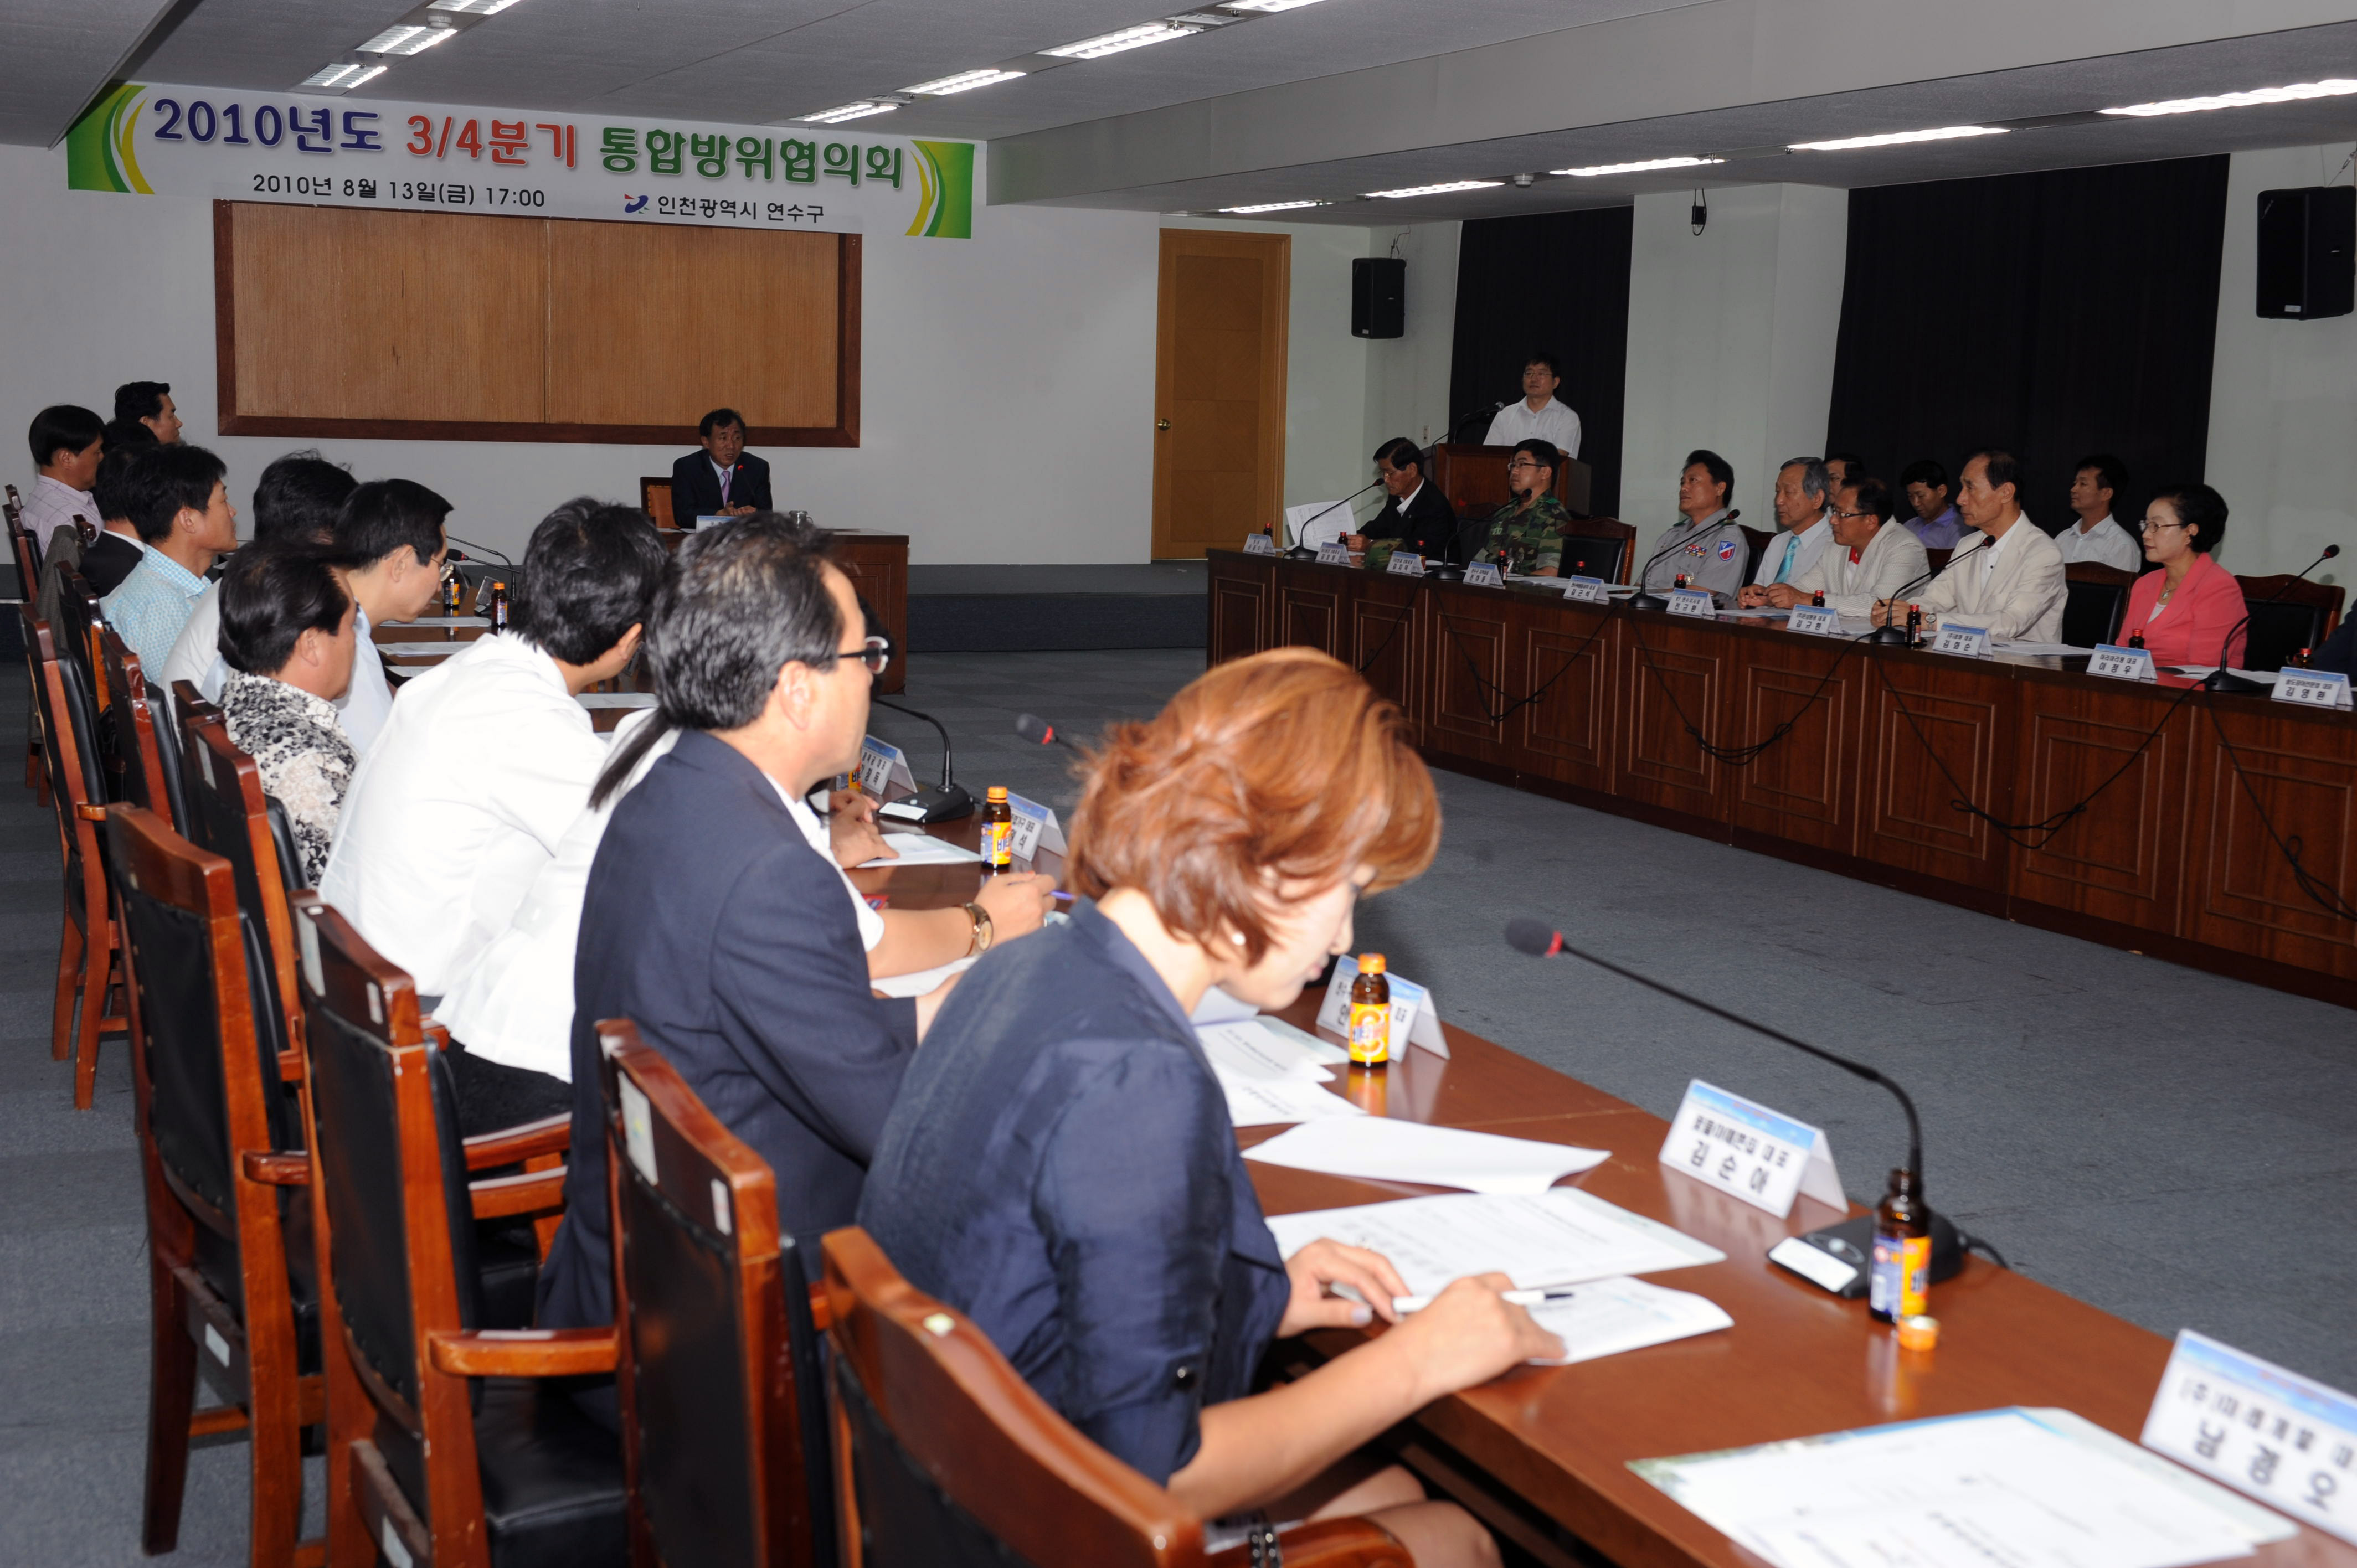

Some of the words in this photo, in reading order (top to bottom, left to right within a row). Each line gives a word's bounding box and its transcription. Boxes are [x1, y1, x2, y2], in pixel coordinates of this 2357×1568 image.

[153, 98, 383, 153] 2010년도
[406, 115, 575, 169] 3/4분기
[599, 125, 903, 189] 통합방위협의회
[253, 174, 332, 197] 2010년
[343, 179, 378, 199] 8월
[390, 181, 475, 207] 13일(금)
[485, 187, 545, 208] 17:00
[658, 196, 757, 220] 인천광역시
[767, 204, 824, 224] 연수구
